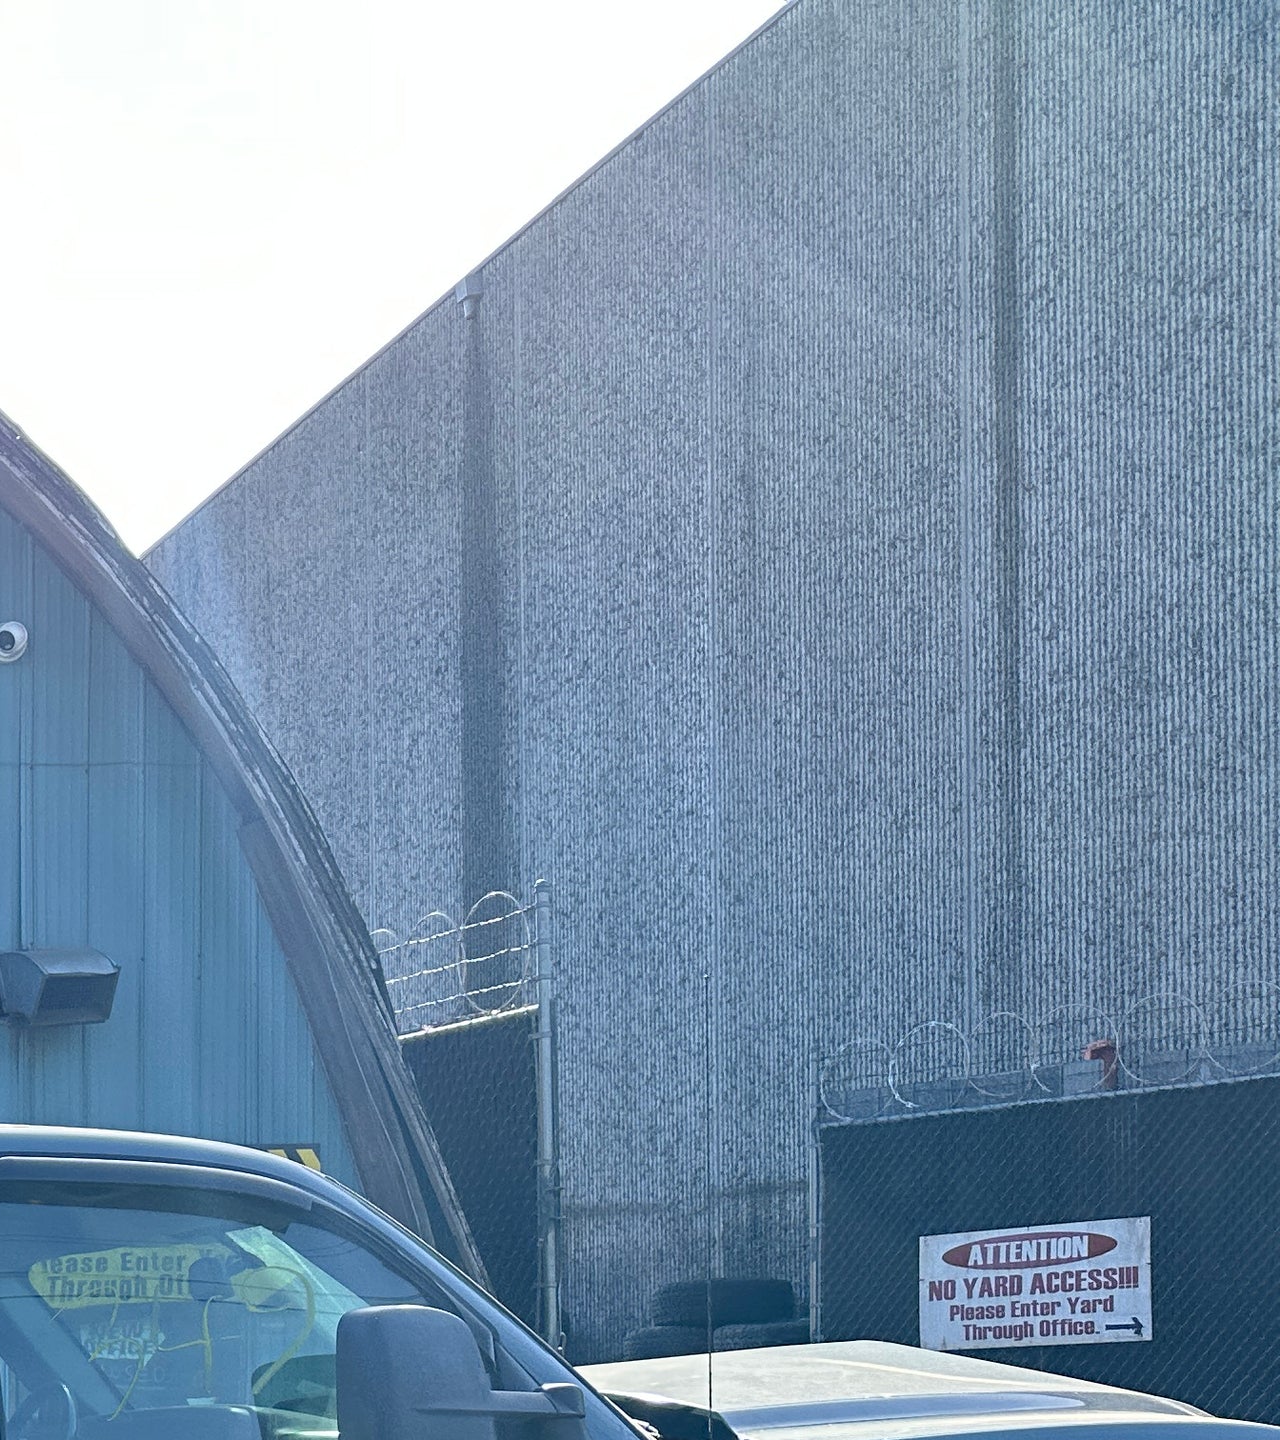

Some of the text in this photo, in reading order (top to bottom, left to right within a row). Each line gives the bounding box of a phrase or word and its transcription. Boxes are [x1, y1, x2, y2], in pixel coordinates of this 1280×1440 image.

[41, 1254, 109, 1274] lease
[120, 1251, 187, 1272] Enter
[967, 1235, 1089, 1267] ATTENTION
[928, 1266, 1139, 1302] NO YARD ACCESS!!!
[949, 1295, 1115, 1321] Please Enter Yard
[963, 1319, 1101, 1341] Through Office.
